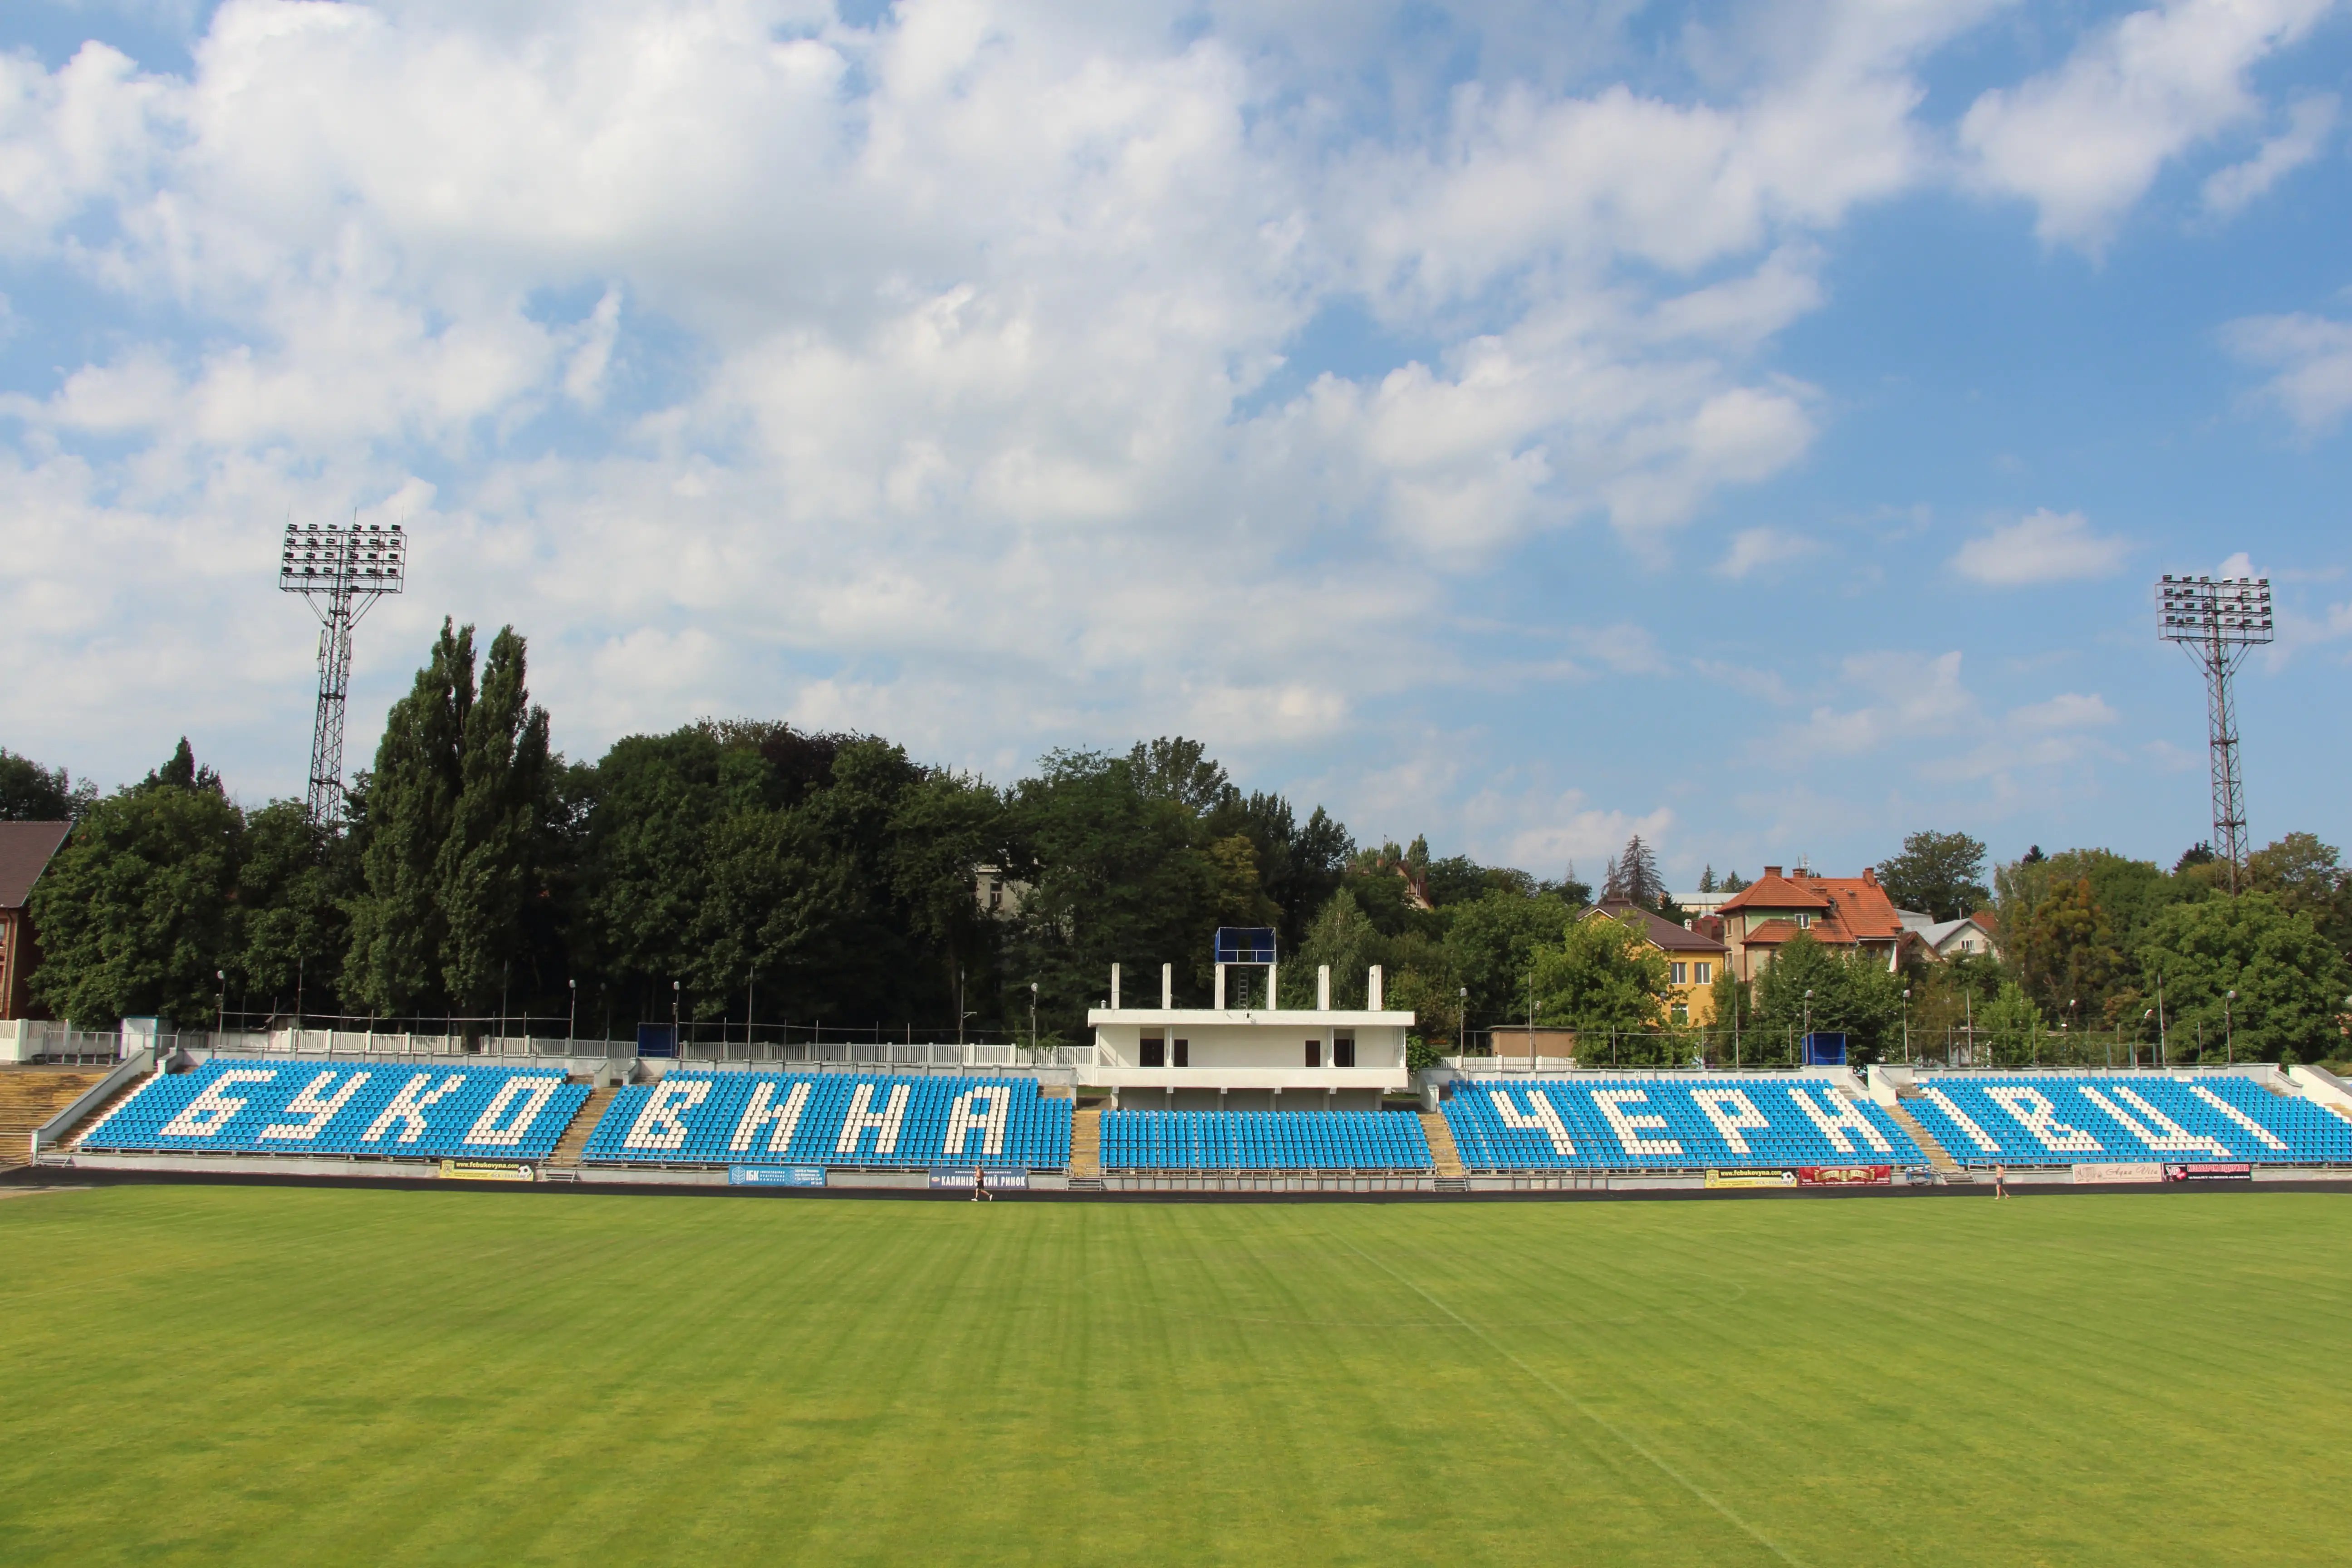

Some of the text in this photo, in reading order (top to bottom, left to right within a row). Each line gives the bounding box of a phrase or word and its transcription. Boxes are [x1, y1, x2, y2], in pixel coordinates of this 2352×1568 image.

[159, 1069, 2289, 1156] БУКОВИНА ЧЕРНІВЦІ
[746, 1170, 759, 1181] ІБК
[941, 1175, 1025, 1186] КАЛИНІВСКИЙ РИНОК
